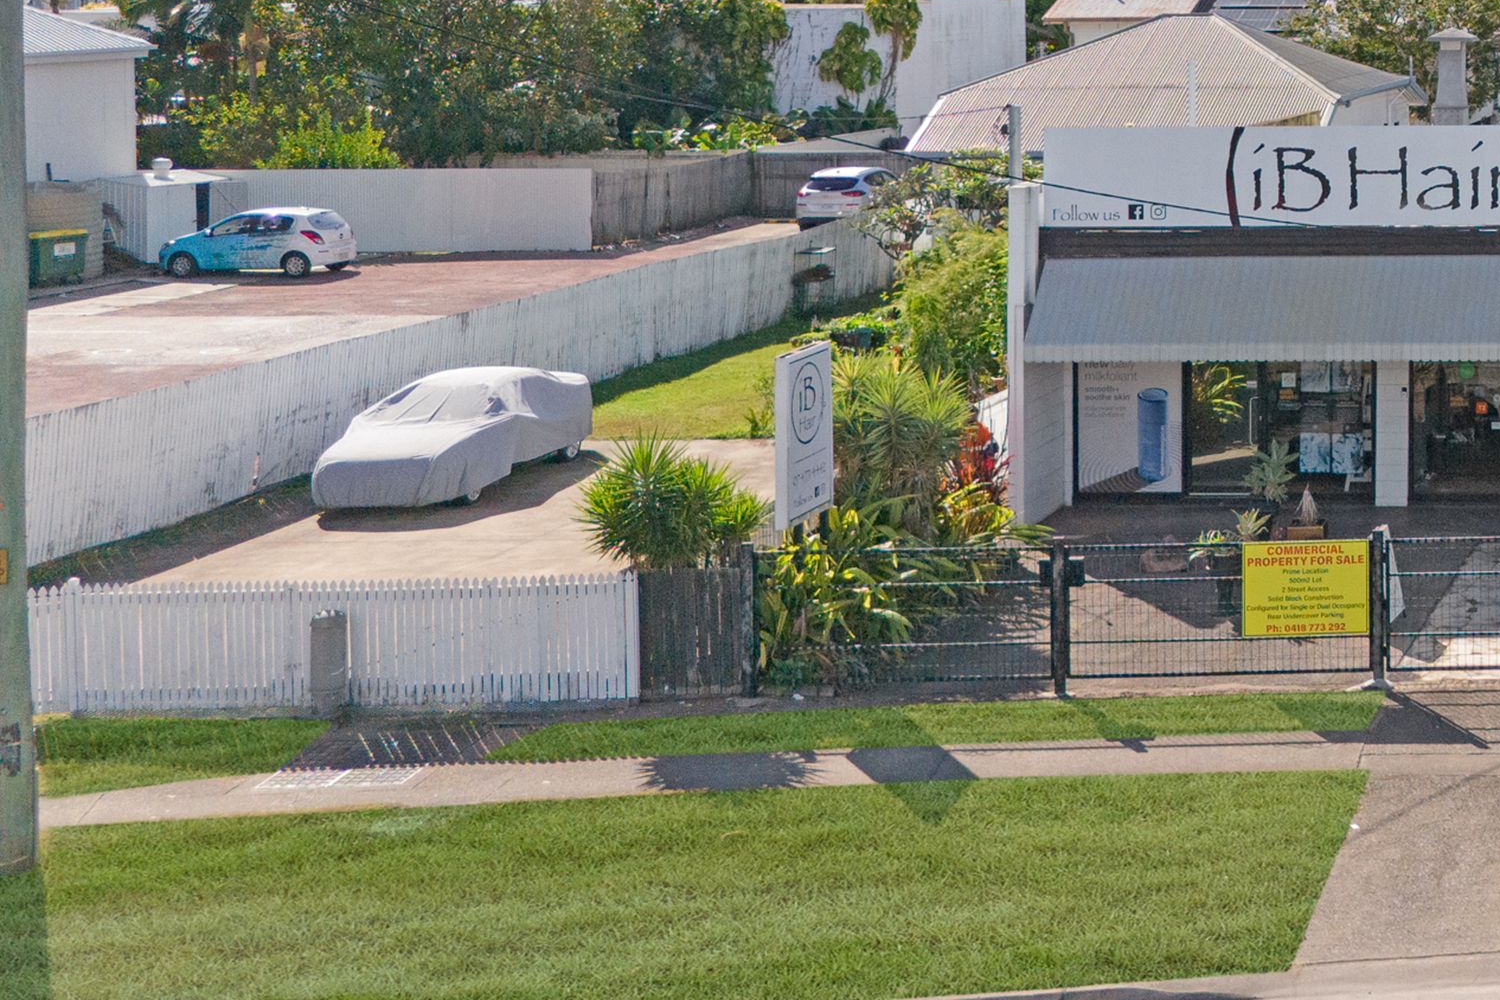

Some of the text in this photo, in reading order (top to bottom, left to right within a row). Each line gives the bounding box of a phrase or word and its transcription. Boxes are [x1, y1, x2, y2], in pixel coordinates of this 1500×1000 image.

[1053, 204, 1121, 221] Follow us
[1267, 545, 1344, 556] COMMERCIAL
[1247, 555, 1365, 567] PROPERTY FOR SALE
[1246, 604, 1279, 612] Configured
[1331, 602, 1365, 610] Occupancy
[1266, 622, 1346, 633] Ph: 0418 773 292
